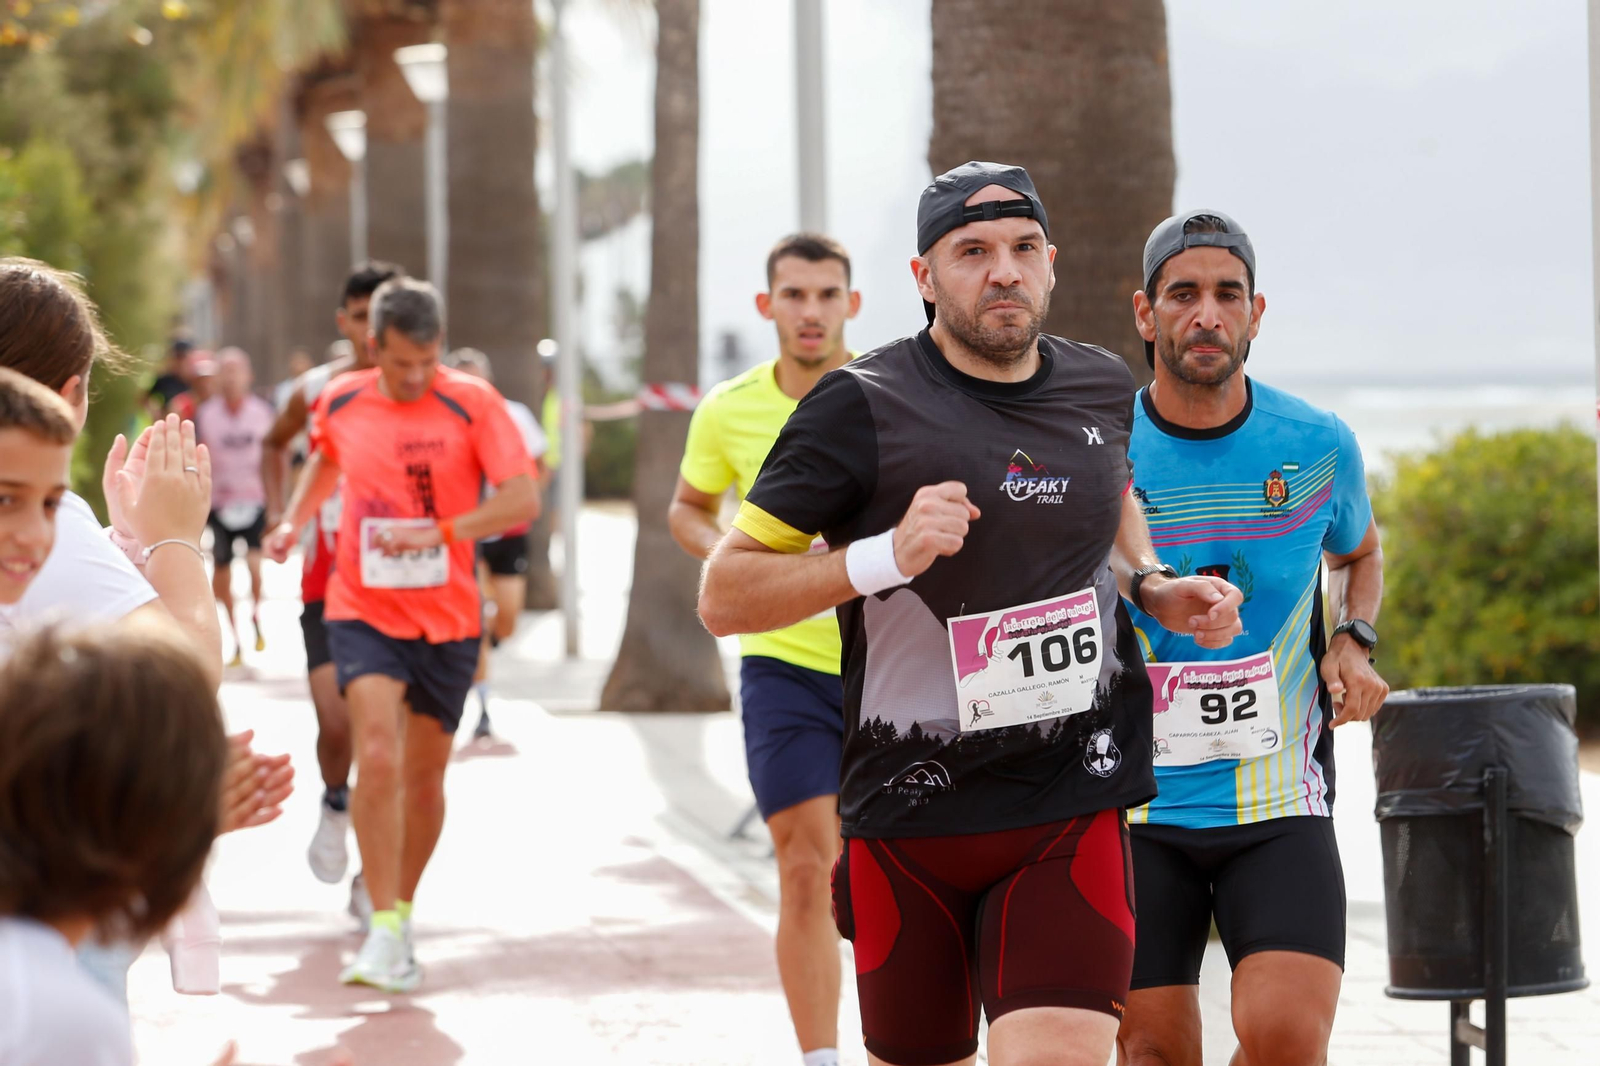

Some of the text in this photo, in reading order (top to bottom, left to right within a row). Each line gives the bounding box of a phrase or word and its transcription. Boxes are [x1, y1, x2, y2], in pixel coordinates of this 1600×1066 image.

[1015, 476, 1070, 494] PEAKY
[1036, 495, 1064, 504] TRAIL
[1067, 602, 1094, 617] valores
[1007, 626, 1097, 678] 106
[988, 677, 1070, 698] CAZALLA GALLEGO, RAMÓN
[1033, 710, 1060, 720] Septiembre
[1200, 689, 1258, 725] 92
